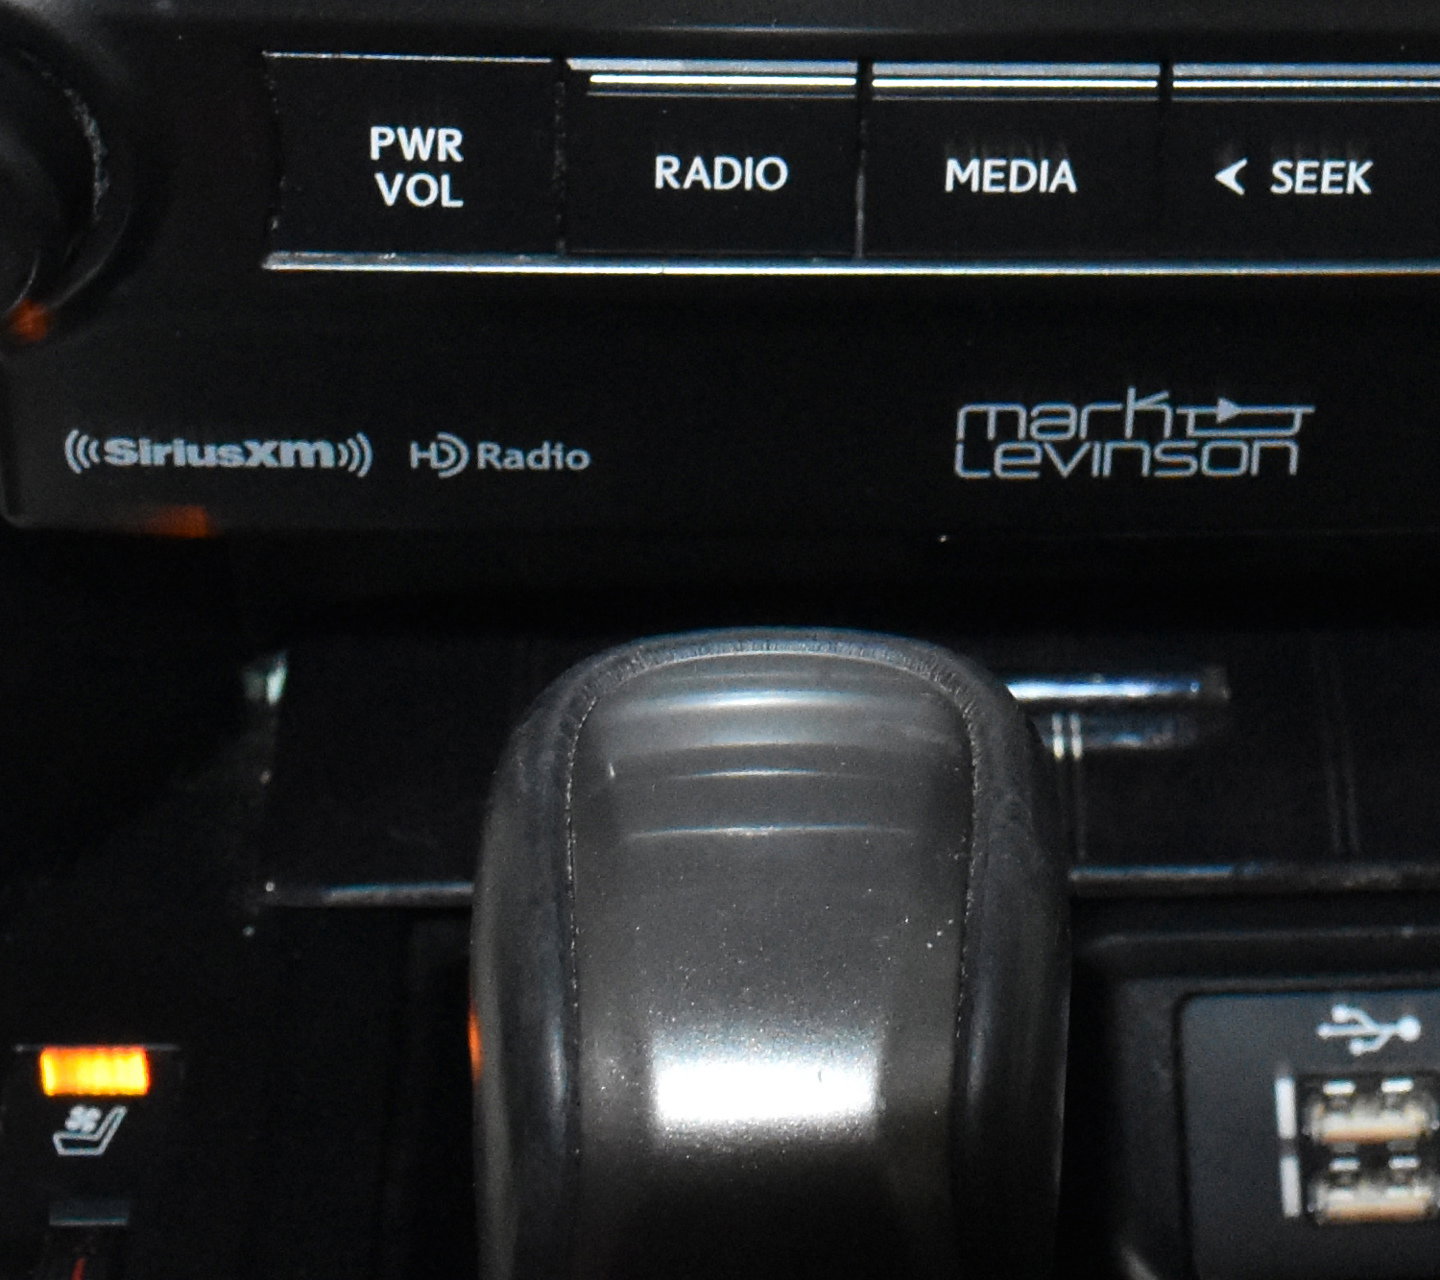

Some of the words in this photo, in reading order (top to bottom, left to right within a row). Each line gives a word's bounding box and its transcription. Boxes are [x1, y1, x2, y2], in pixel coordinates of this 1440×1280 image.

[371, 126, 463, 162] PWR
[375, 172, 463, 207] VOL
[655, 155, 788, 191] RADIO
[946, 158, 1077, 193] MEDIA
[1271, 160, 1373, 194] SEEK
[956, 386, 1174, 442] mark
[478, 441, 591, 470] Radio
